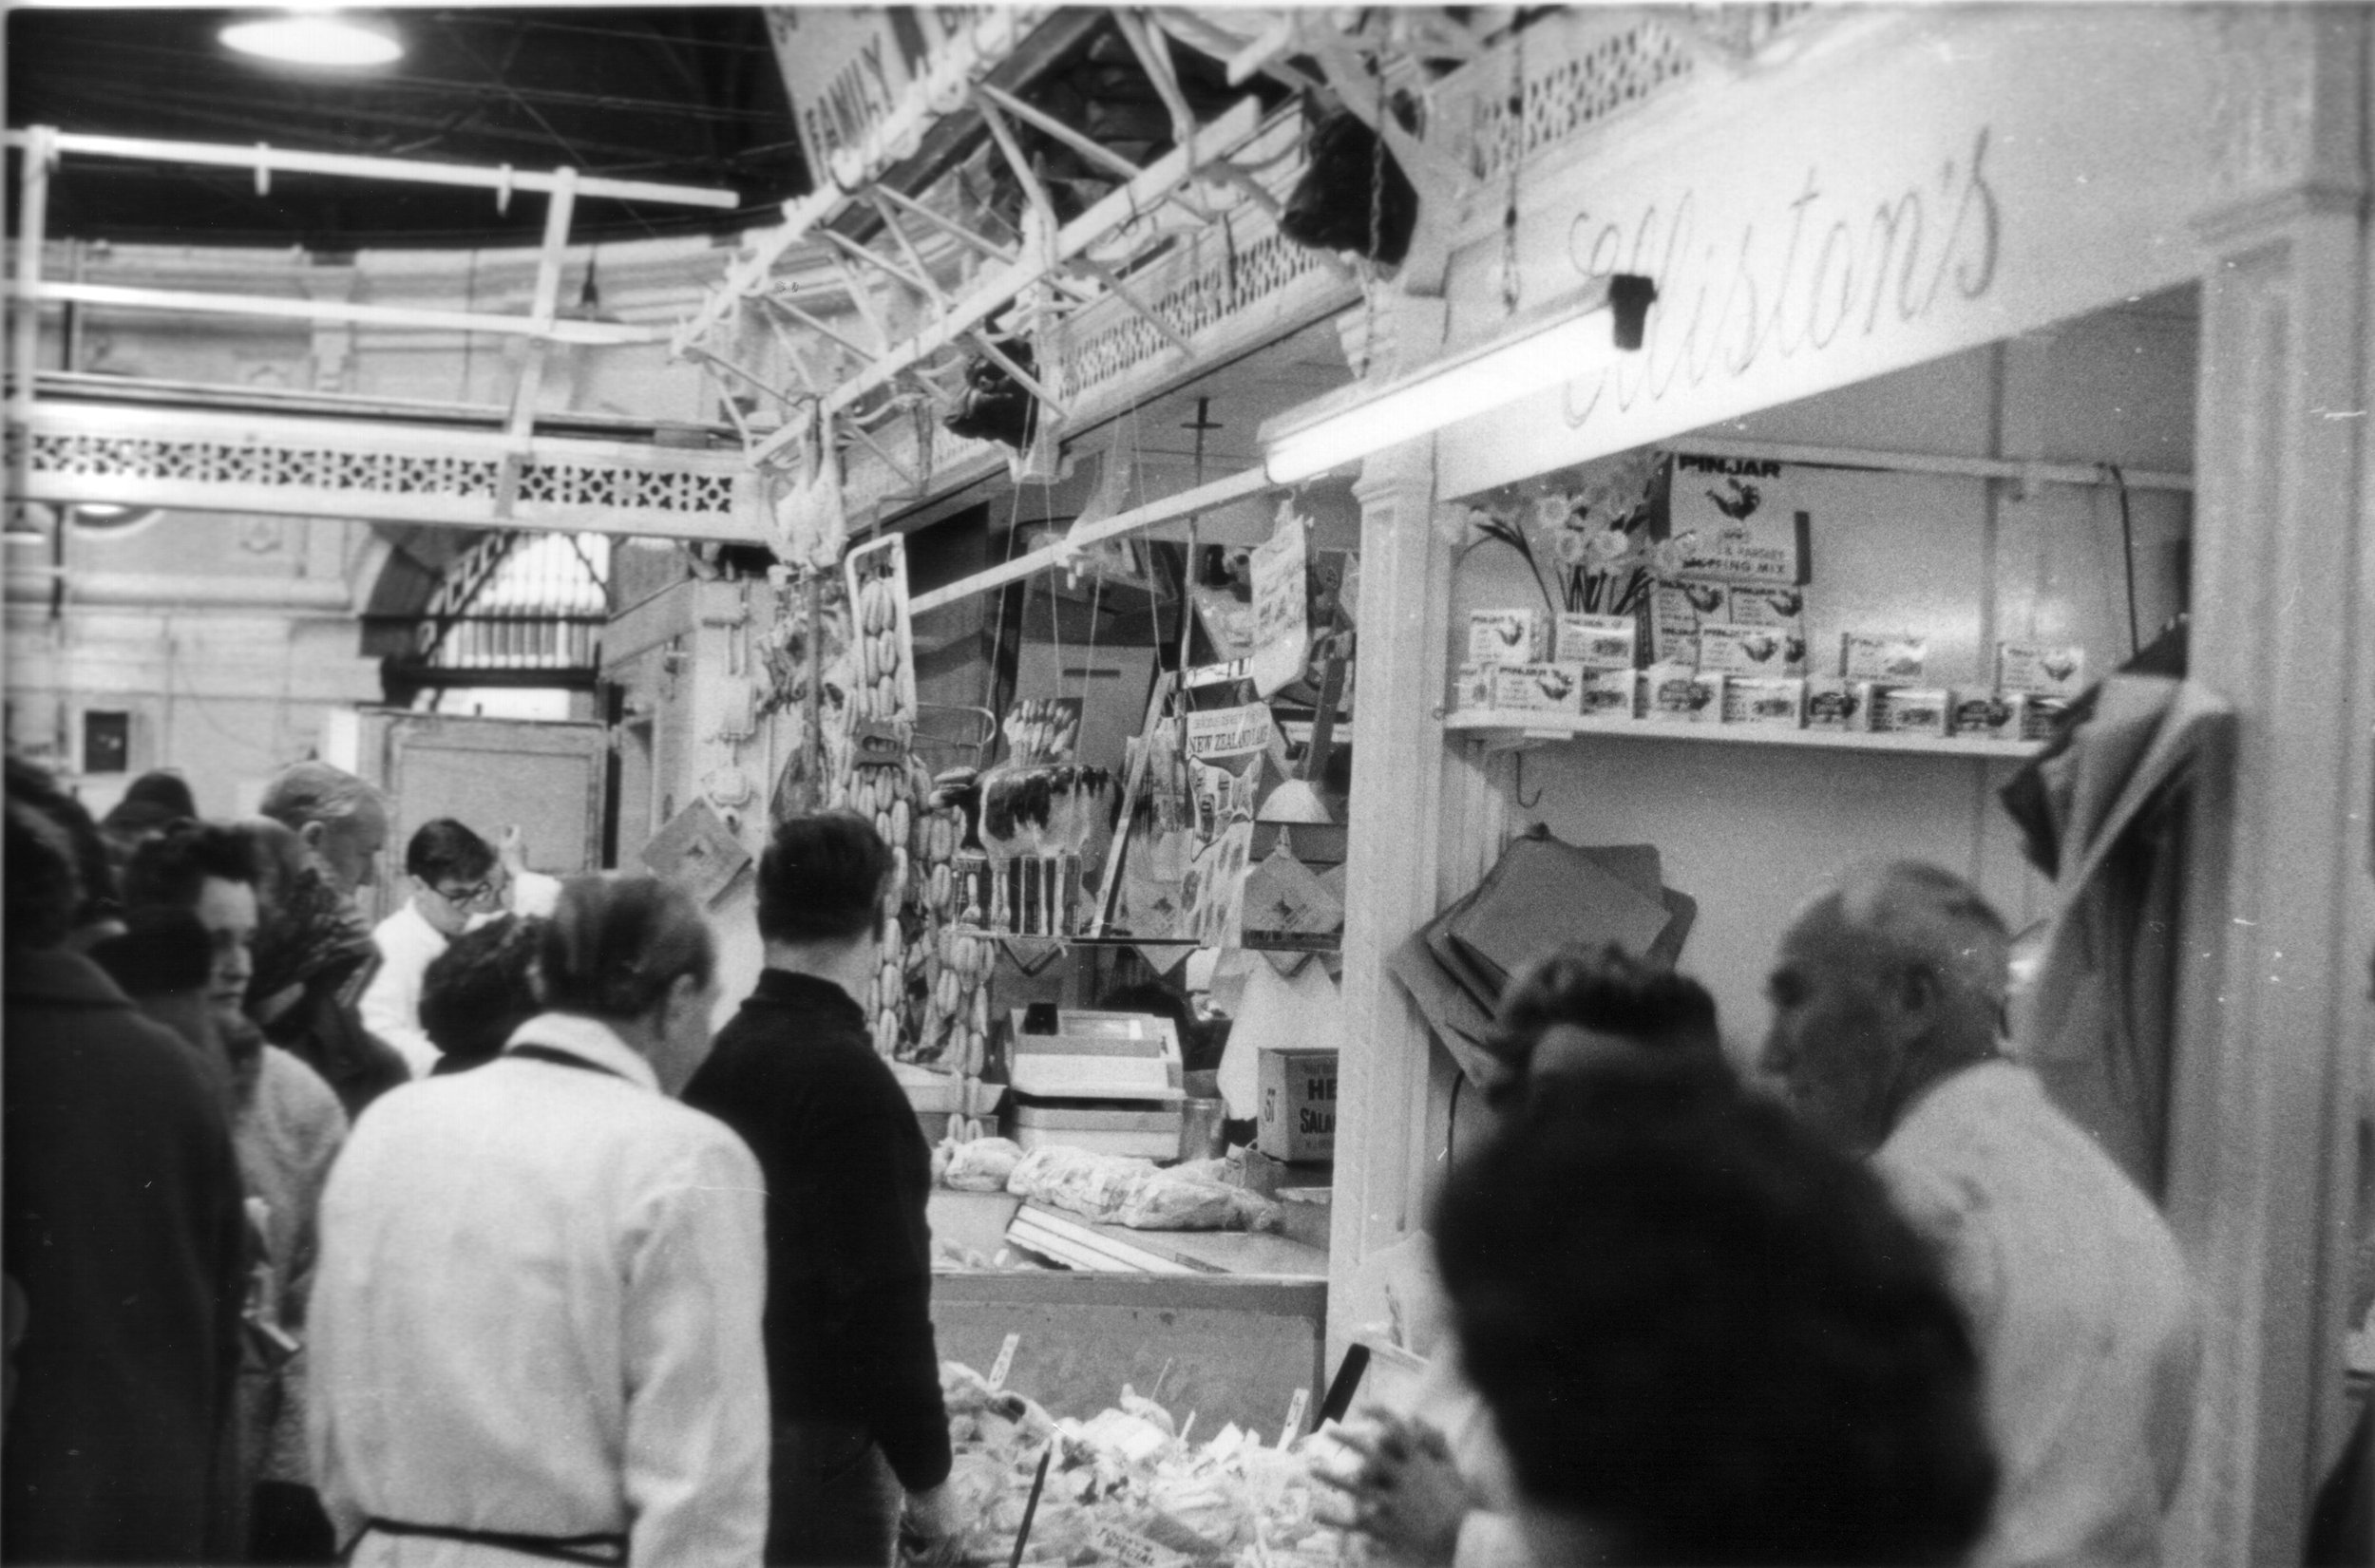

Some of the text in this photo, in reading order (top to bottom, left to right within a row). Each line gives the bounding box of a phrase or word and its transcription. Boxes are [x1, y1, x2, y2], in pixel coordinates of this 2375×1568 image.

[1678, 455, 1781, 478] PINJAR
[1188, 734, 1212, 754] NEW
[1213, 727, 1254, 752] ZEALAND
[1300, 1107, 1336, 1134] SALA
